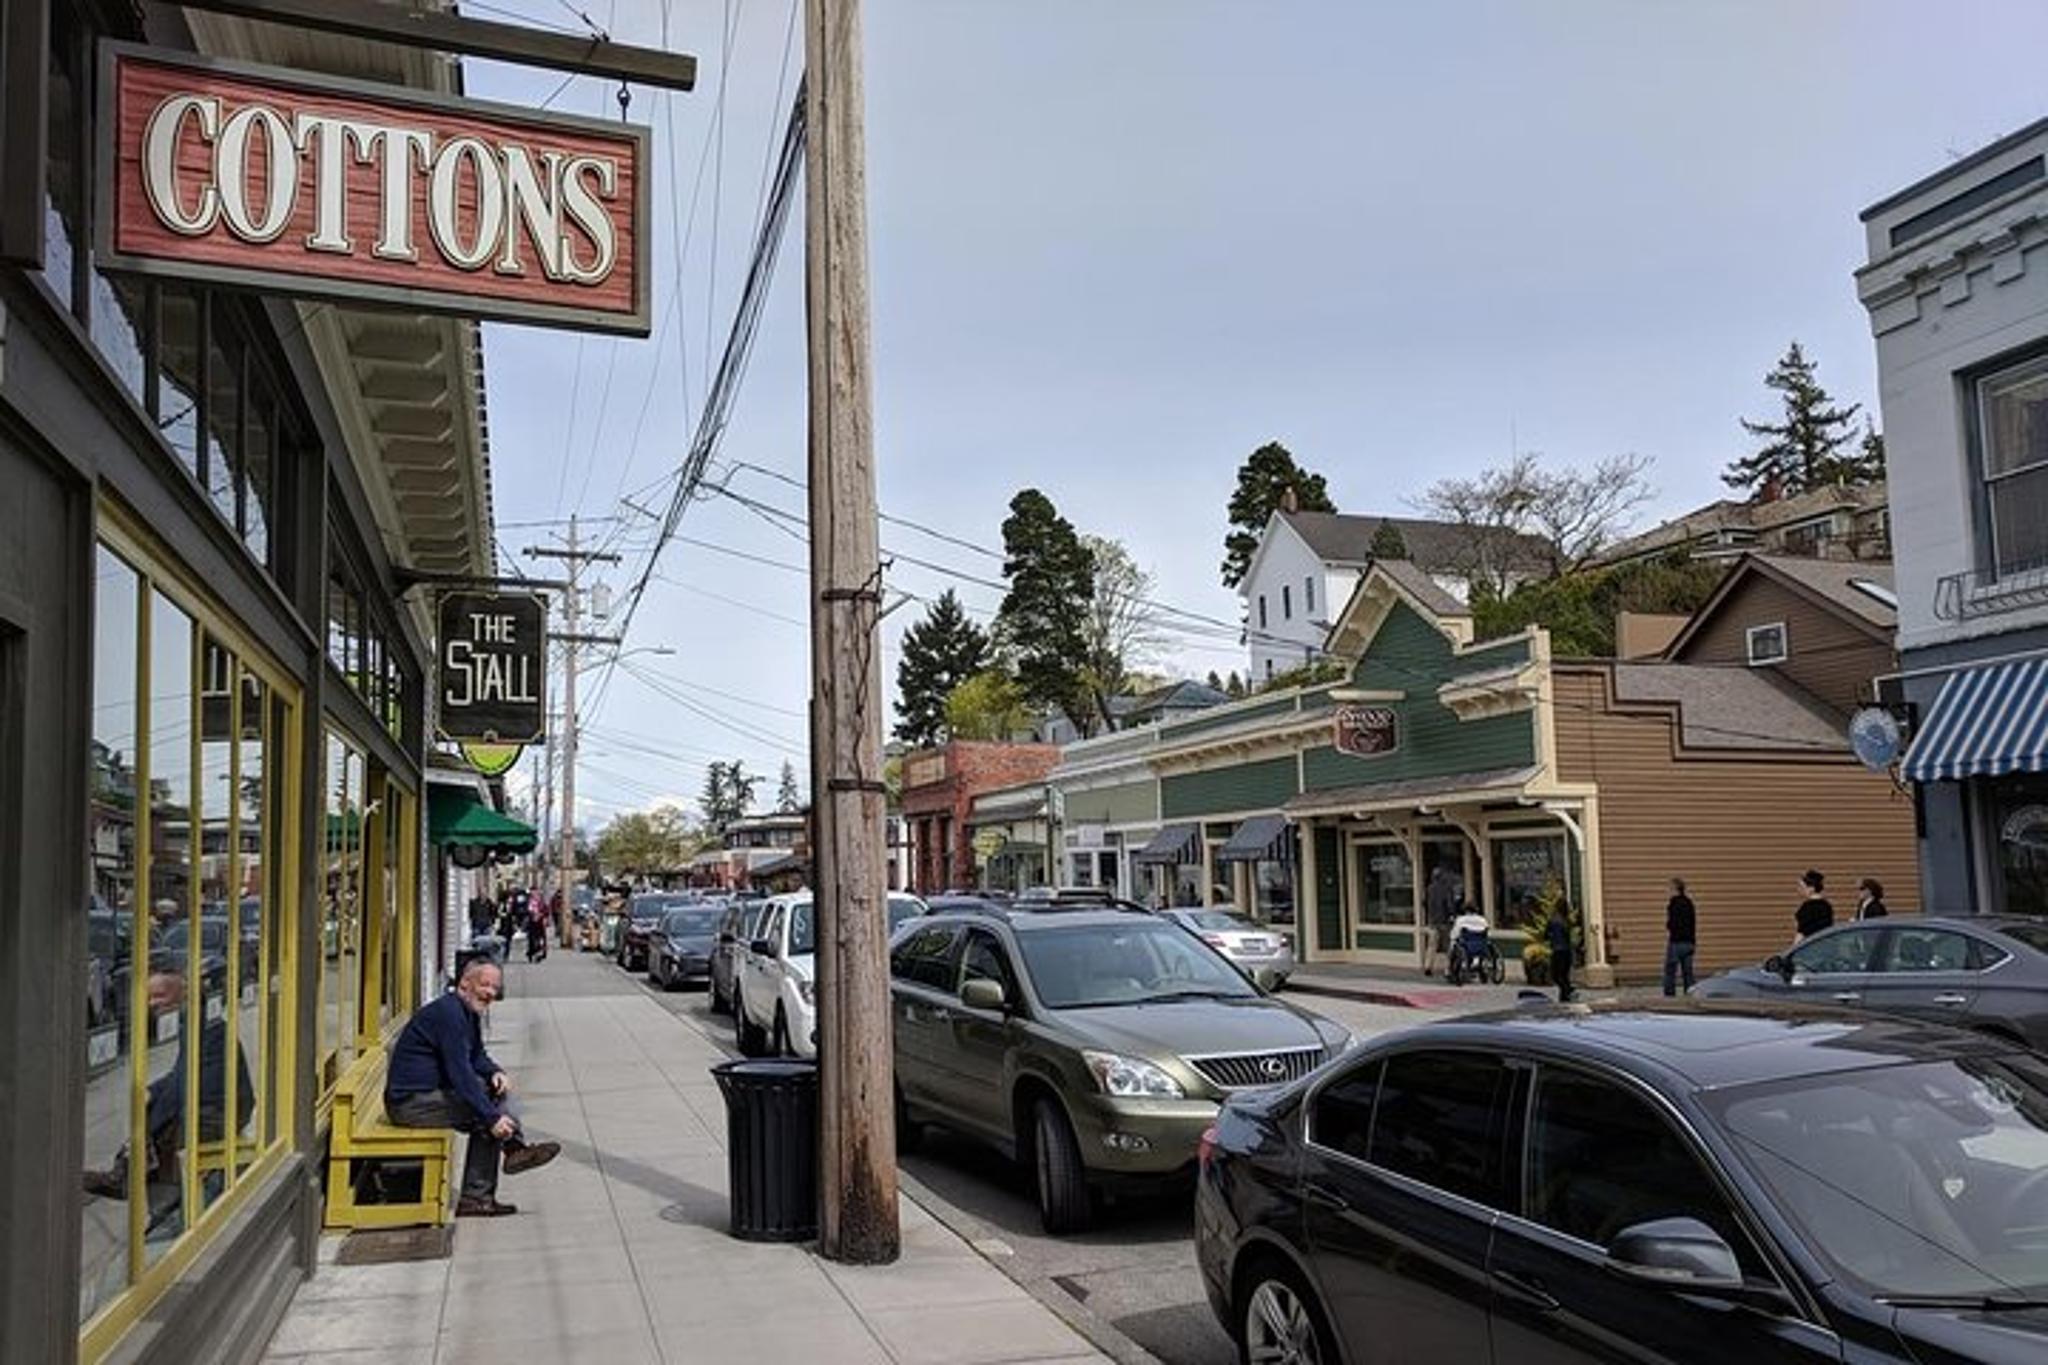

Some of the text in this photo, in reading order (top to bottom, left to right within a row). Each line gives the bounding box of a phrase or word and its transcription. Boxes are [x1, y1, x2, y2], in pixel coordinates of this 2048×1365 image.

[142, 93, 617, 284] COTTONS
[469, 613, 516, 644] THE
[446, 640, 538, 706] STALL
